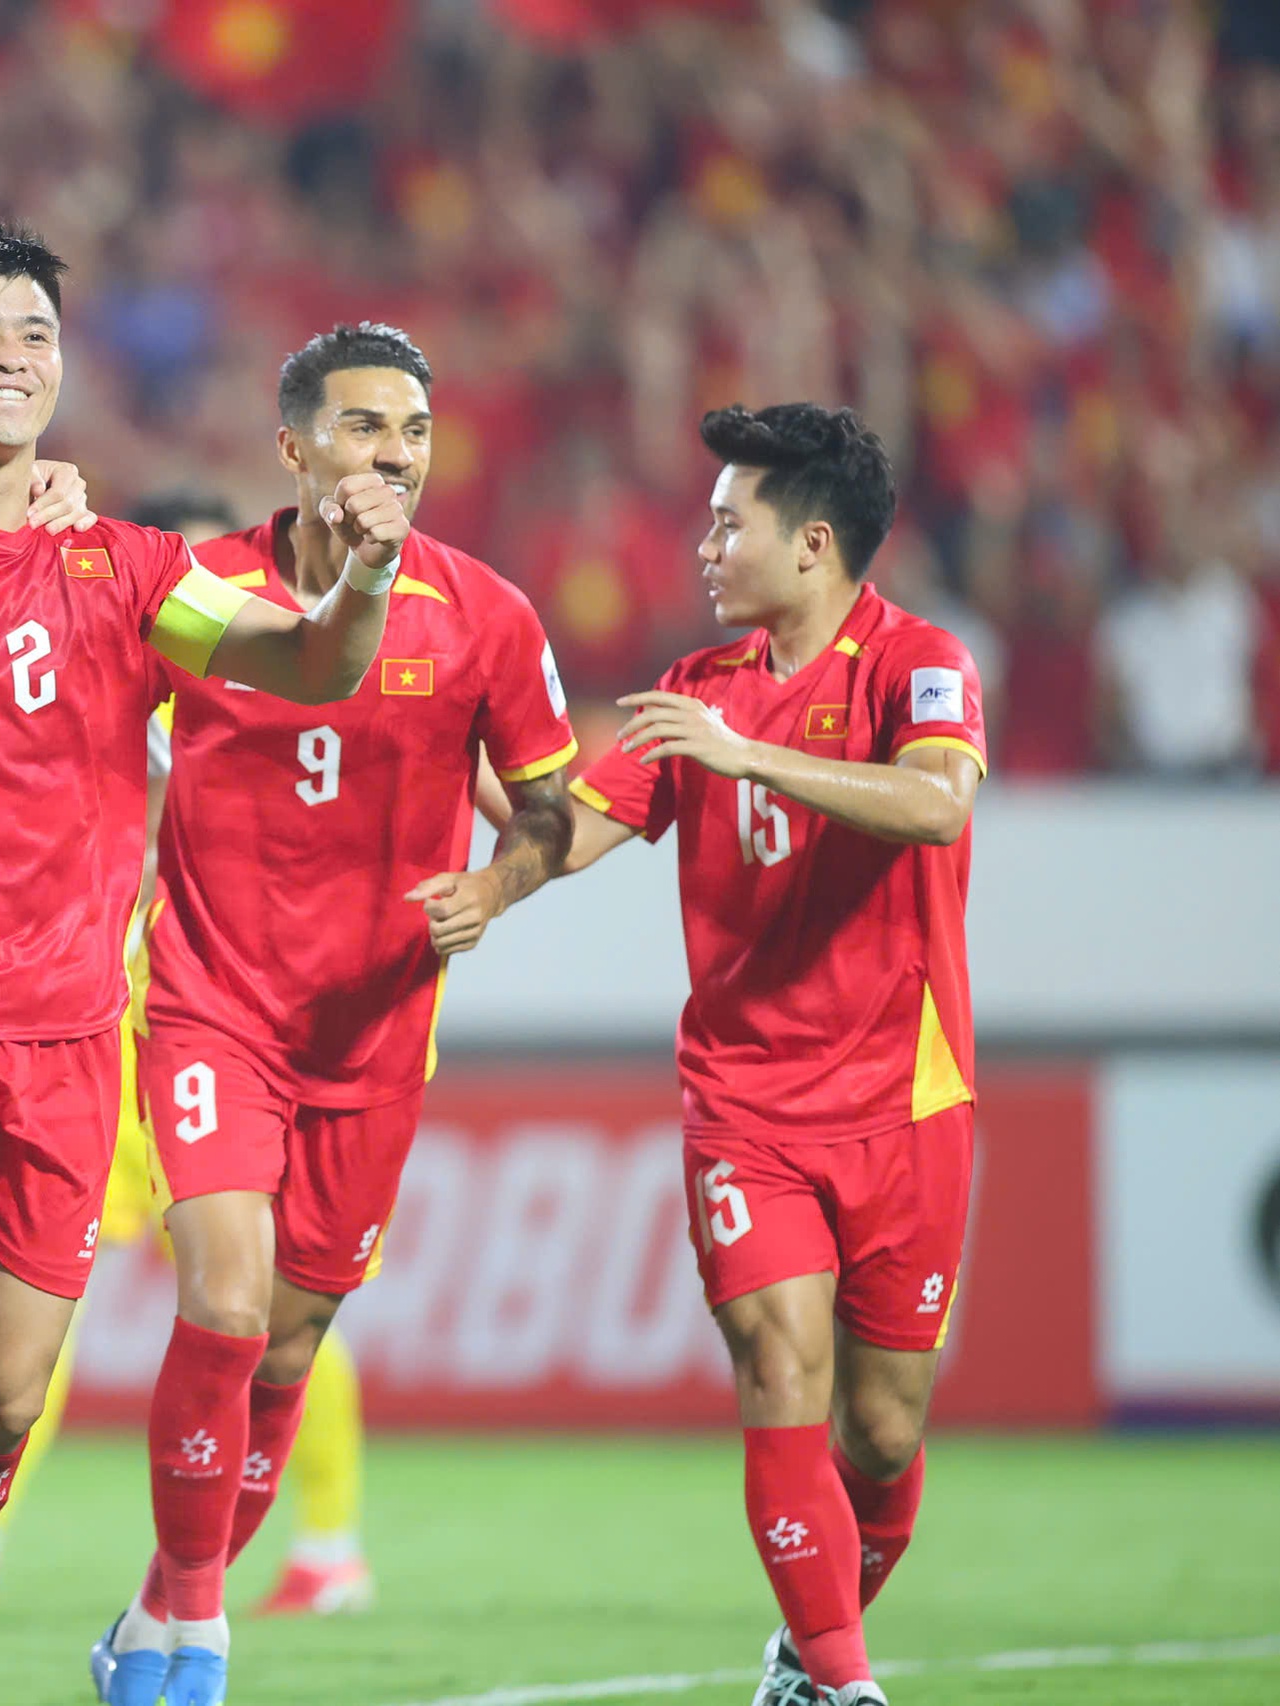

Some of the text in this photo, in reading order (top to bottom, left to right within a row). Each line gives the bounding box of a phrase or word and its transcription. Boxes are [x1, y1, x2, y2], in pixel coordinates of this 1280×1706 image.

[8, 620, 56, 714] 2
[919, 687, 955, 700] AFC
[295, 725, 342, 806] 9
[737, 778, 791, 867] 15
[173, 1061, 219, 1144] 9
[695, 1159, 752, 1256] 15
